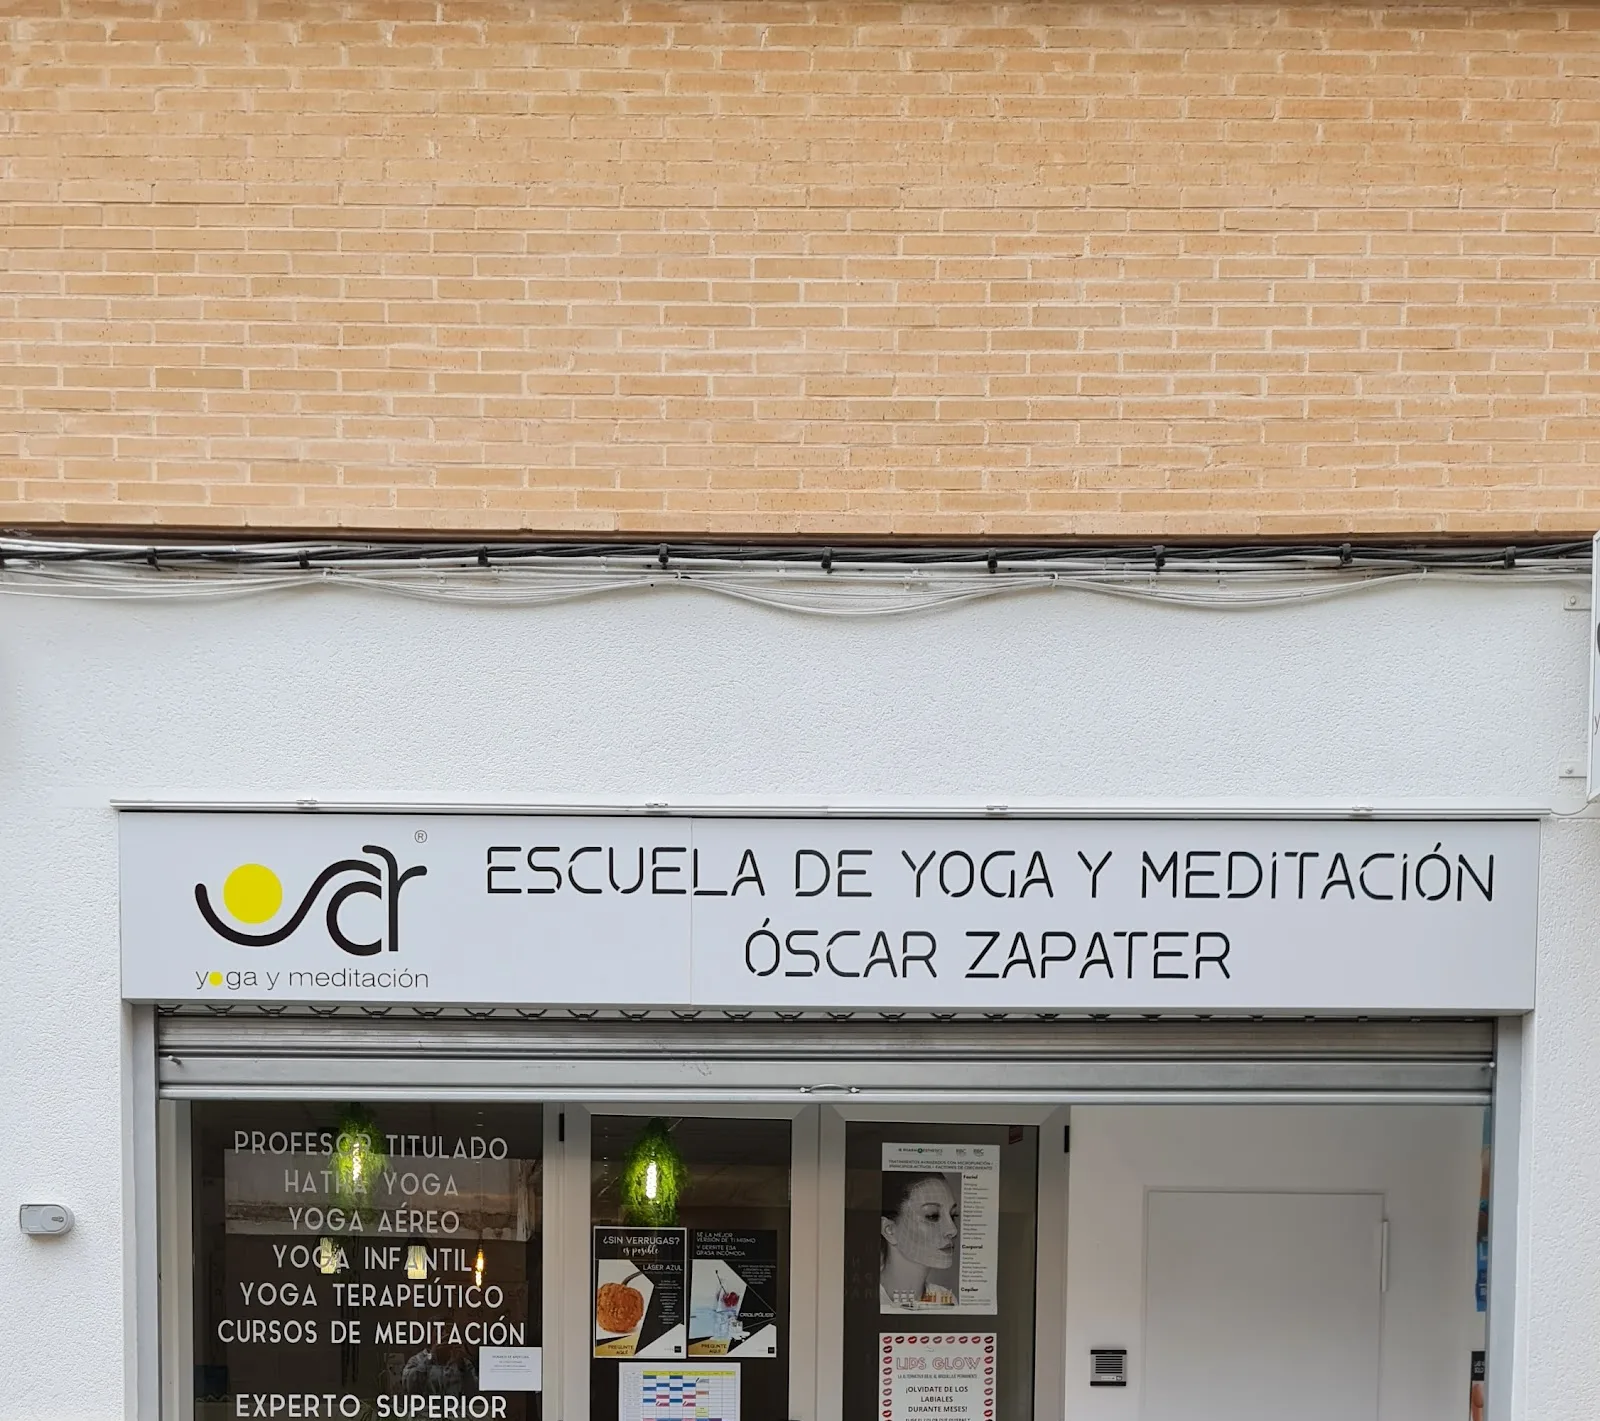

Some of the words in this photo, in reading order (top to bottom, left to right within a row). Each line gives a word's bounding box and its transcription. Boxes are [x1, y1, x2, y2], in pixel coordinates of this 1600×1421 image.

[486, 846, 765, 897] ESCUELA
[795, 848, 873, 898] DE
[901, 850, 1054, 899] YOGA
[1077, 850, 1113, 899] Y
[745, 917, 938, 978] ÓSCAR
[965, 931, 1231, 980] ZAPATER
[195, 970, 257, 990] yoga
[266, 971, 280, 990] y
[289, 968, 428, 988] meditación
[234, 1131, 371, 1156] PROFESOR
[386, 1134, 508, 1160] TITULADO
[383, 1172, 459, 1196] YOGA
[289, 1206, 363, 1232] YOGA
[378, 1202, 460, 1234] AÉREO
[603, 1236, 623, 1245] ¿SIN
[625, 1236, 680, 1245] VERRUGAS?
[272, 1244, 350, 1270] YOGA
[364, 1247, 472, 1272] INFANTIL
[239, 1281, 317, 1307] YOGA
[333, 1277, 503, 1309] TERAPEÚTICO
[217, 1319, 317, 1344] CURSOS
[331, 1321, 361, 1345] DE
[374, 1315, 525, 1346] MEDITACIÓN
[896, 1357, 926, 1370] LIPS
[932, 1357, 981, 1370] GLOW
[236, 1393, 361, 1418] EXPERTO
[377, 1395, 507, 1419] SUPERIOR
